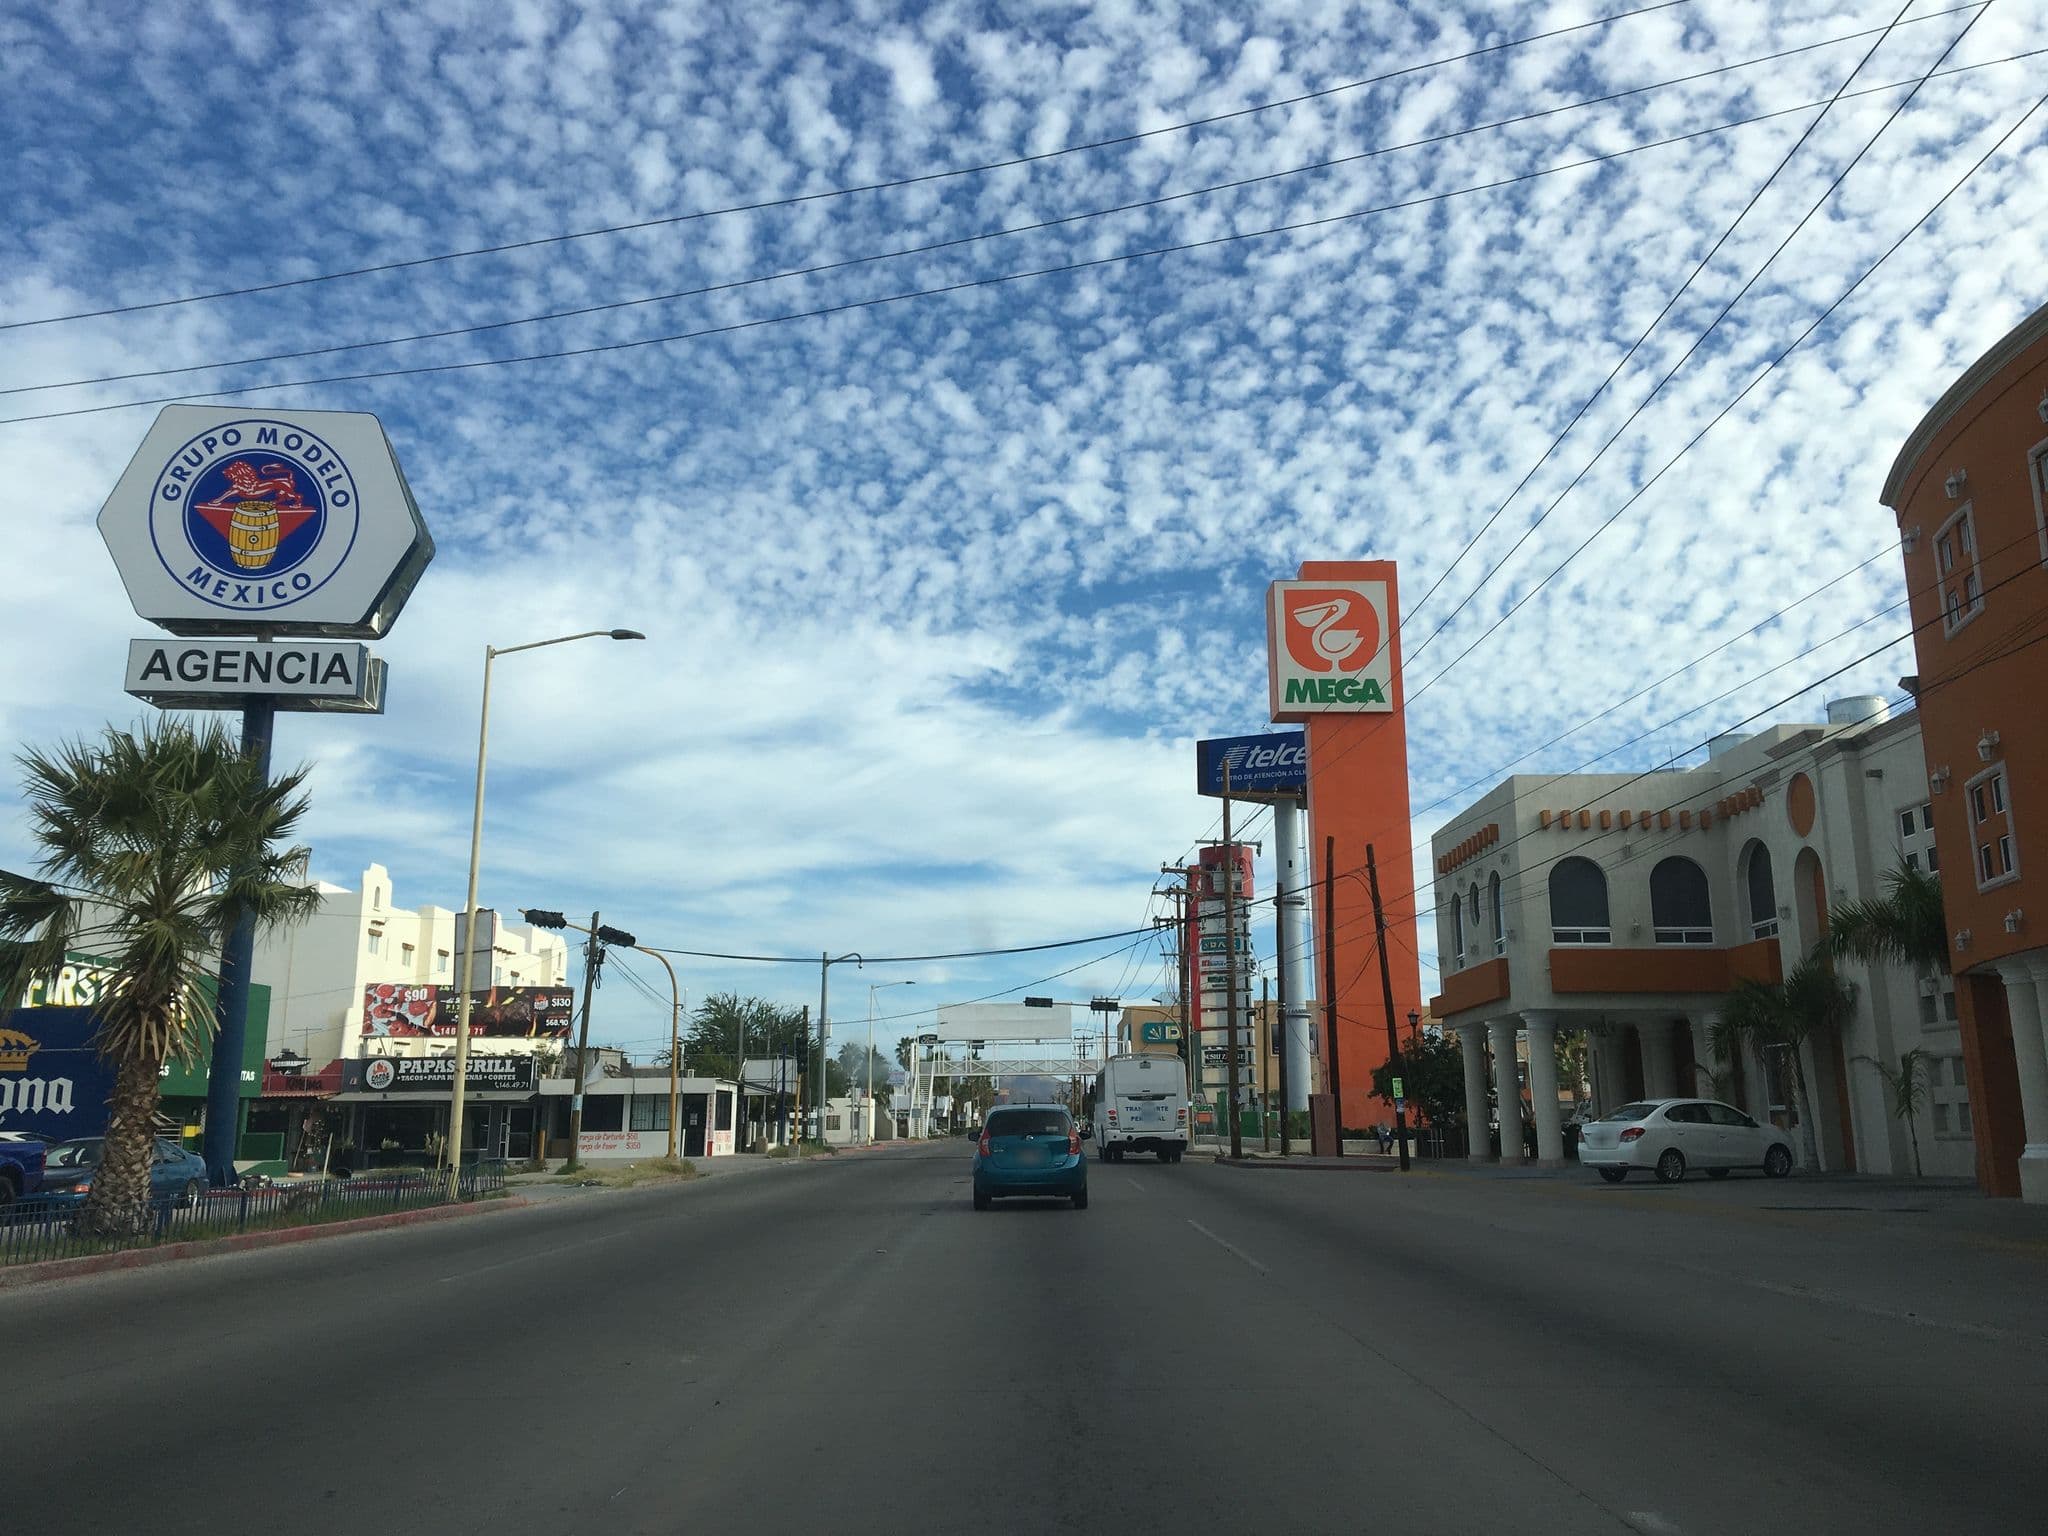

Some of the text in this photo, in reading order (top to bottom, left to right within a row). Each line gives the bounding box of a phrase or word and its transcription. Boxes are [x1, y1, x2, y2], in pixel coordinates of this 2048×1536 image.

[162, 427, 351, 509] GRUPO MODELO
[186, 566, 312, 604] MEXICO
[140, 649, 353, 685] AGENCIA
[1285, 678, 1386, 704] MEGA
[404, 988, 428, 1002] $90
[551, 998, 571, 1008] $130
[398, 1059, 456, 1074] PAPAS
[464, 1059, 516, 1073] GRILL
